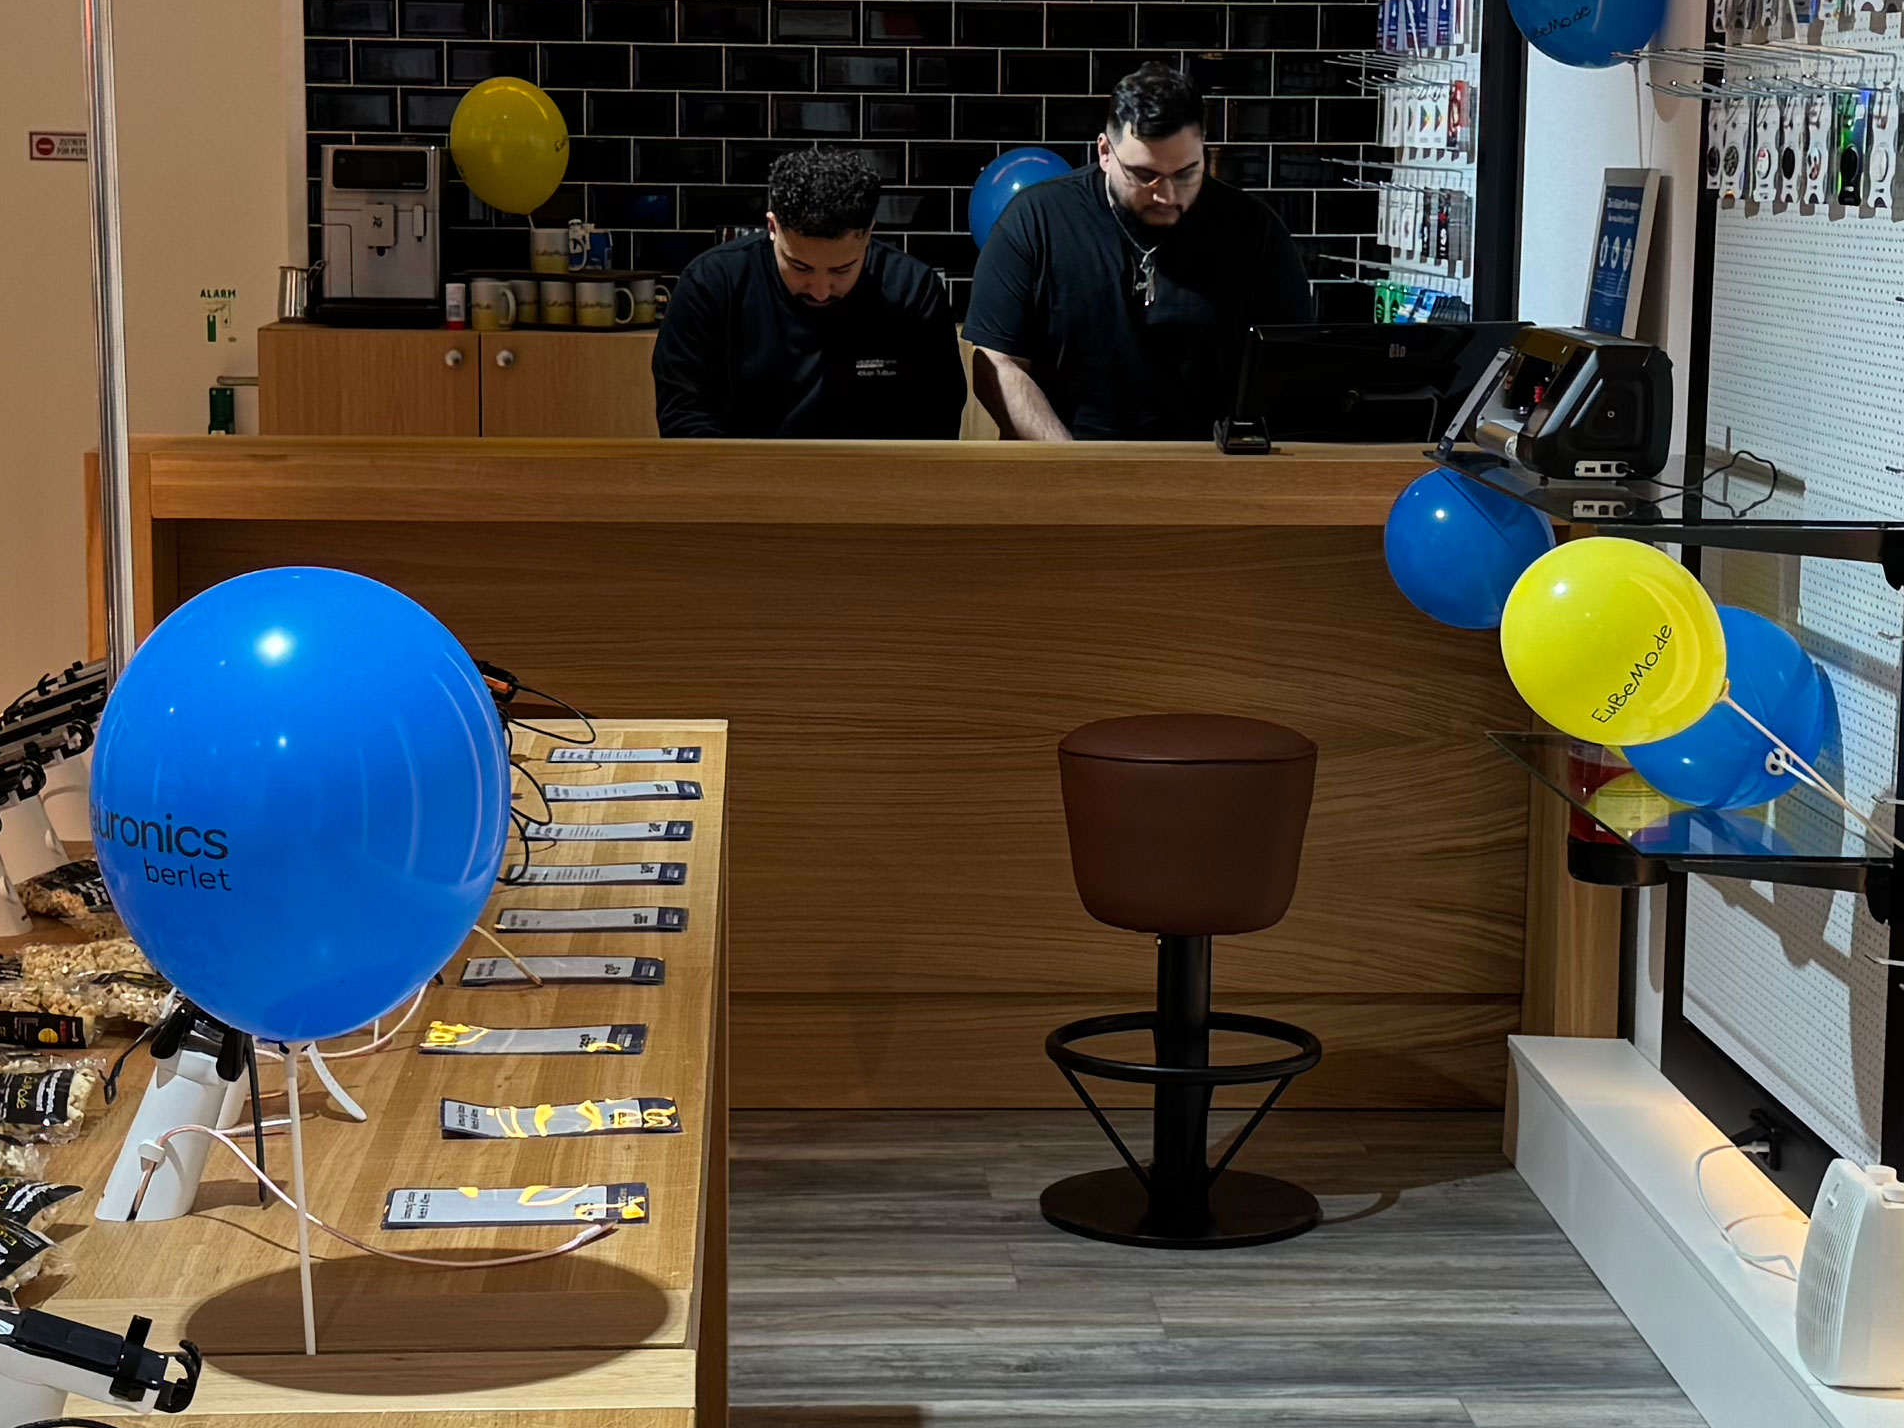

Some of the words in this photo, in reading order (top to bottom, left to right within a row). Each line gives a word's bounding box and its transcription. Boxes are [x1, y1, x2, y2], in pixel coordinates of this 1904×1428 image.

[1530, 4, 1592, 42] BeMo.de
[200, 288, 237, 299] ALARM
[1590, 621, 1673, 726] EuBeMo.de
[99, 801, 229, 860] uronics
[145, 857, 232, 892] berlet
